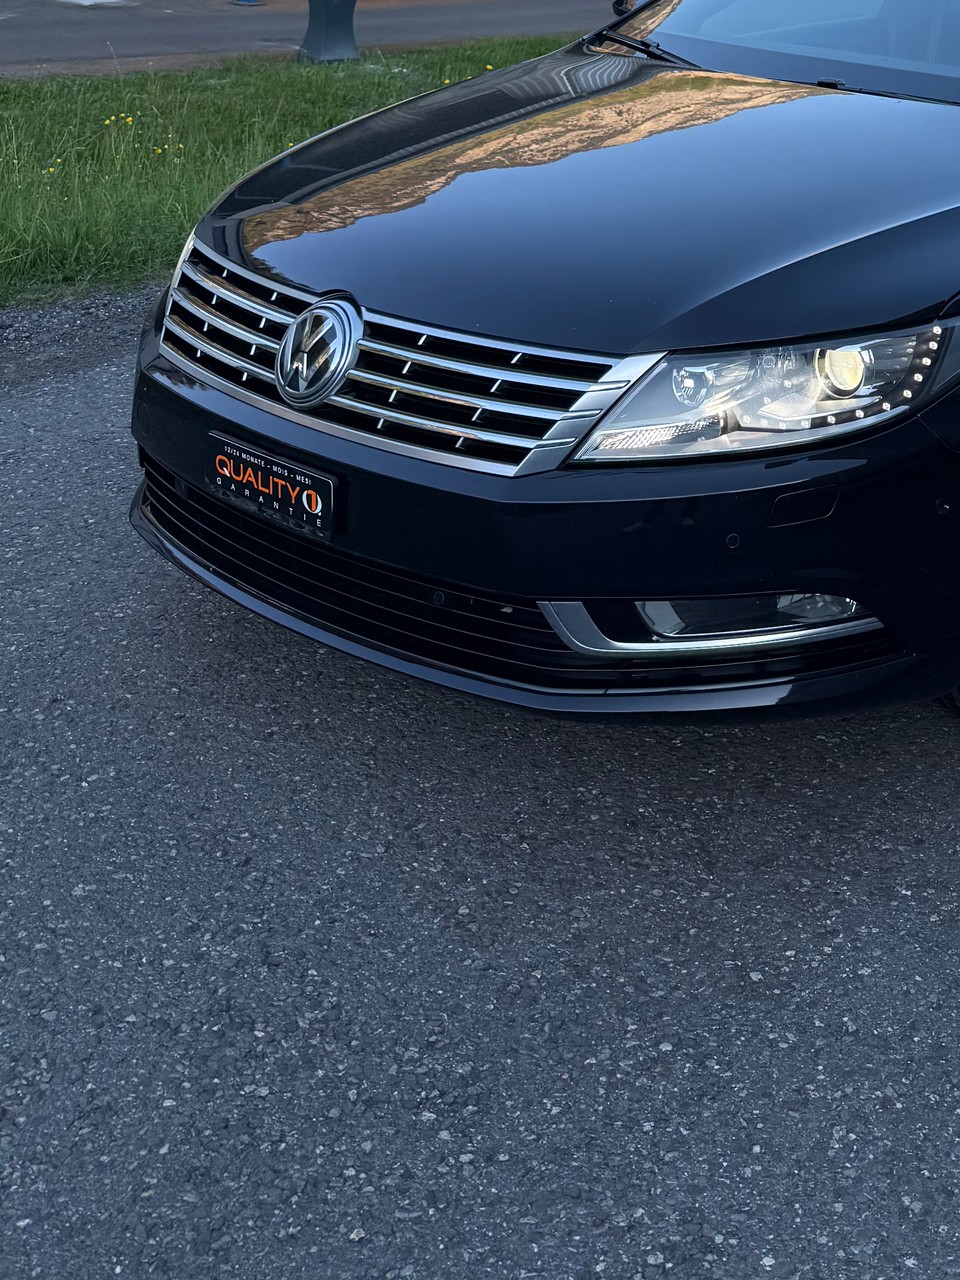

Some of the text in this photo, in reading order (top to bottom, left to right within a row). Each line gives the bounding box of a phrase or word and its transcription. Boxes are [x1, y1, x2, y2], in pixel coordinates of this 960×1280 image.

[241, 452, 265, 468] MONATE
[272, 465, 288, 477] MOIS
[296, 474, 312, 486] MESI
[216, 477, 322, 527] GARANTIE
